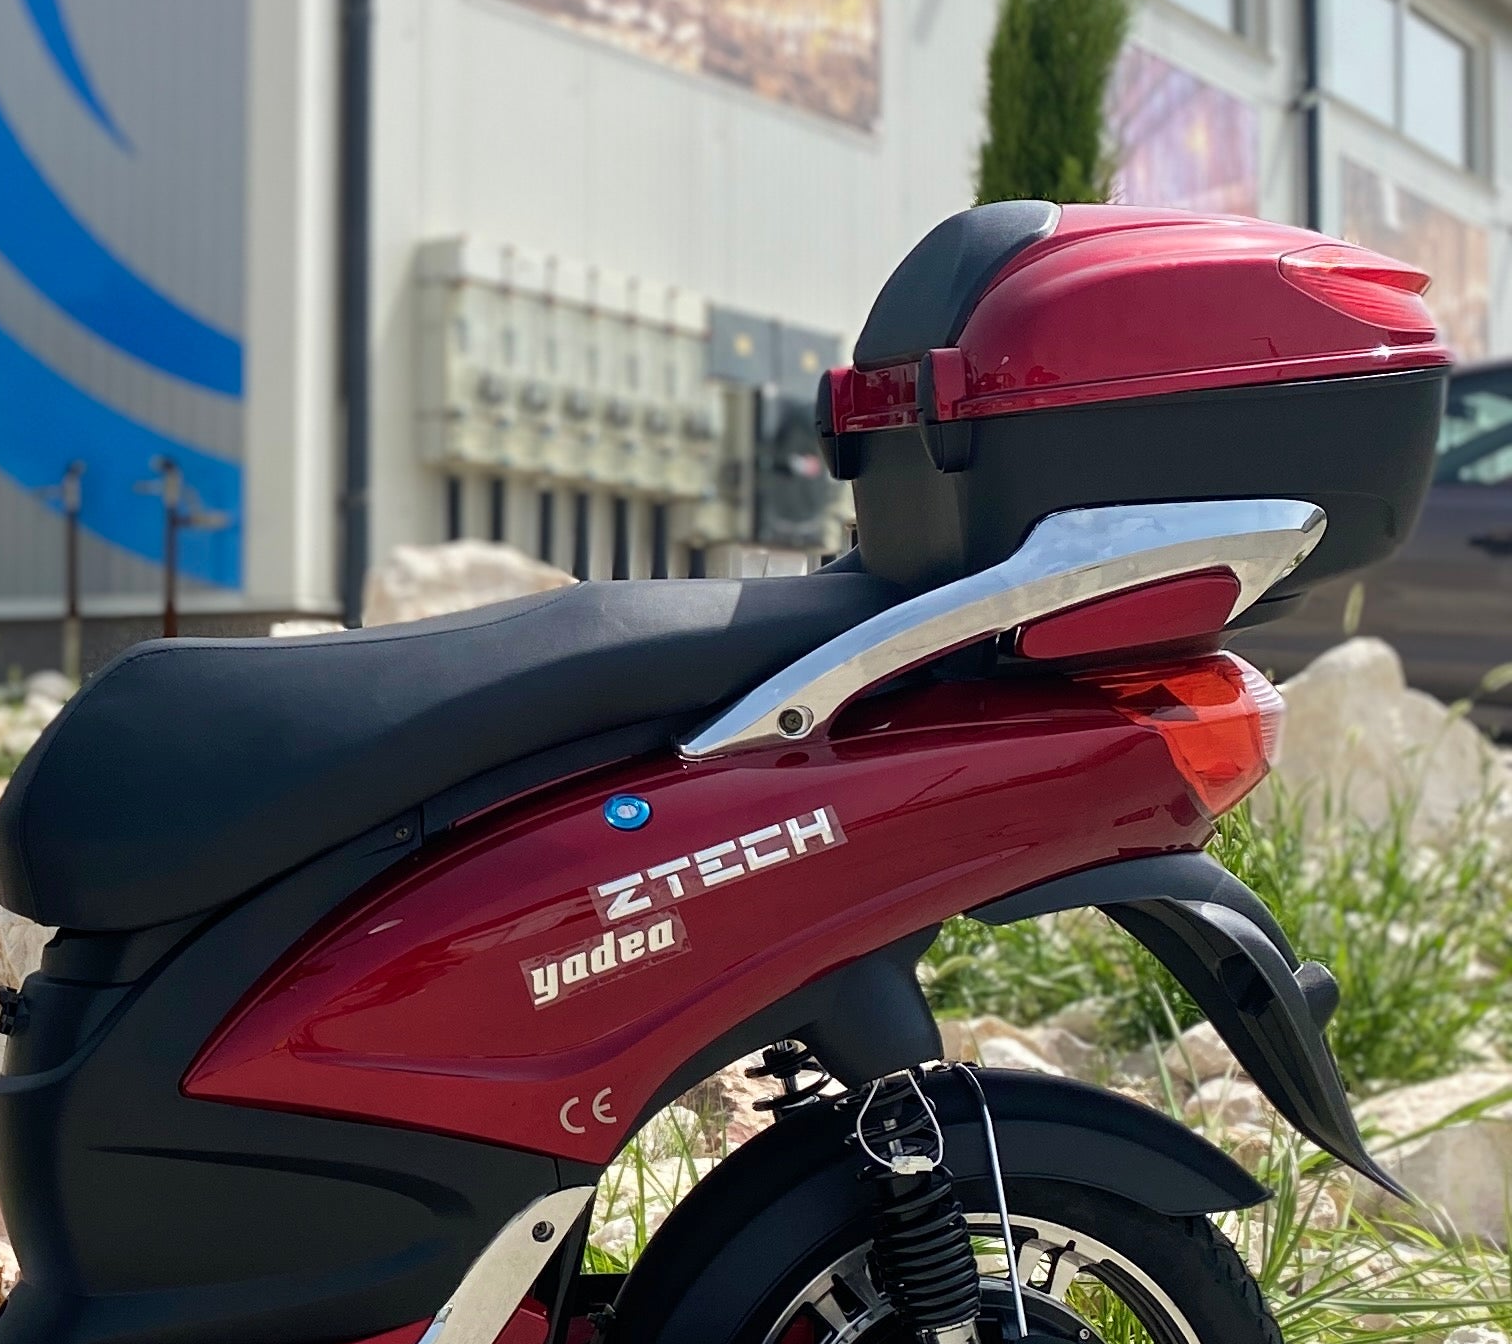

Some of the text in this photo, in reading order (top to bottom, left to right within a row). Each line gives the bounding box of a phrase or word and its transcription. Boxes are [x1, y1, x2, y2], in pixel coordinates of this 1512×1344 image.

[598, 807, 835, 921] ZTECH
[531, 918, 675, 1005] yadea
[559, 1087, 617, 1134] CE
